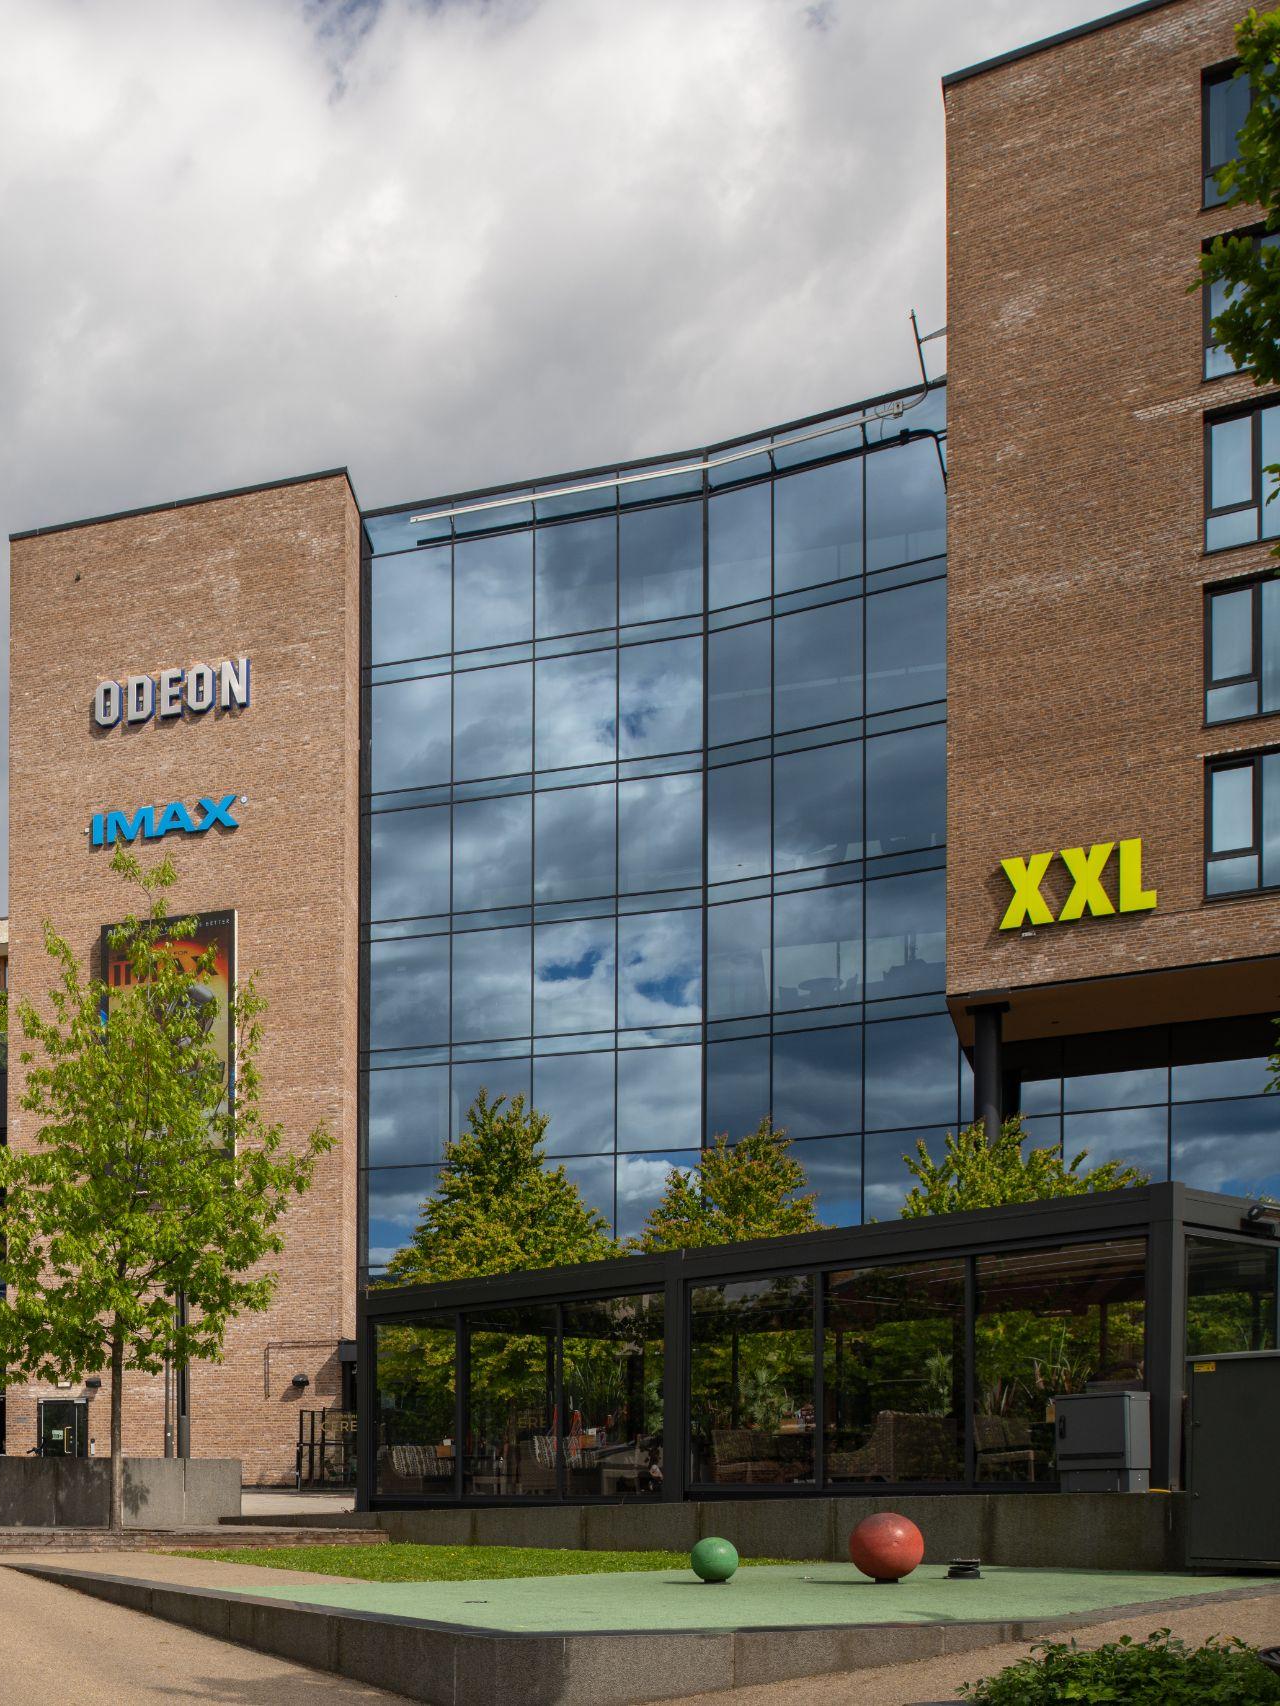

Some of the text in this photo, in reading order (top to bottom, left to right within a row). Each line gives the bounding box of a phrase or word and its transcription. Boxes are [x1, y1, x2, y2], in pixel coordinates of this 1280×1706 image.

[95, 658, 250, 728] ODEON
[92, 794, 239, 846] IMAX
[998, 837, 1157, 931] XXL
